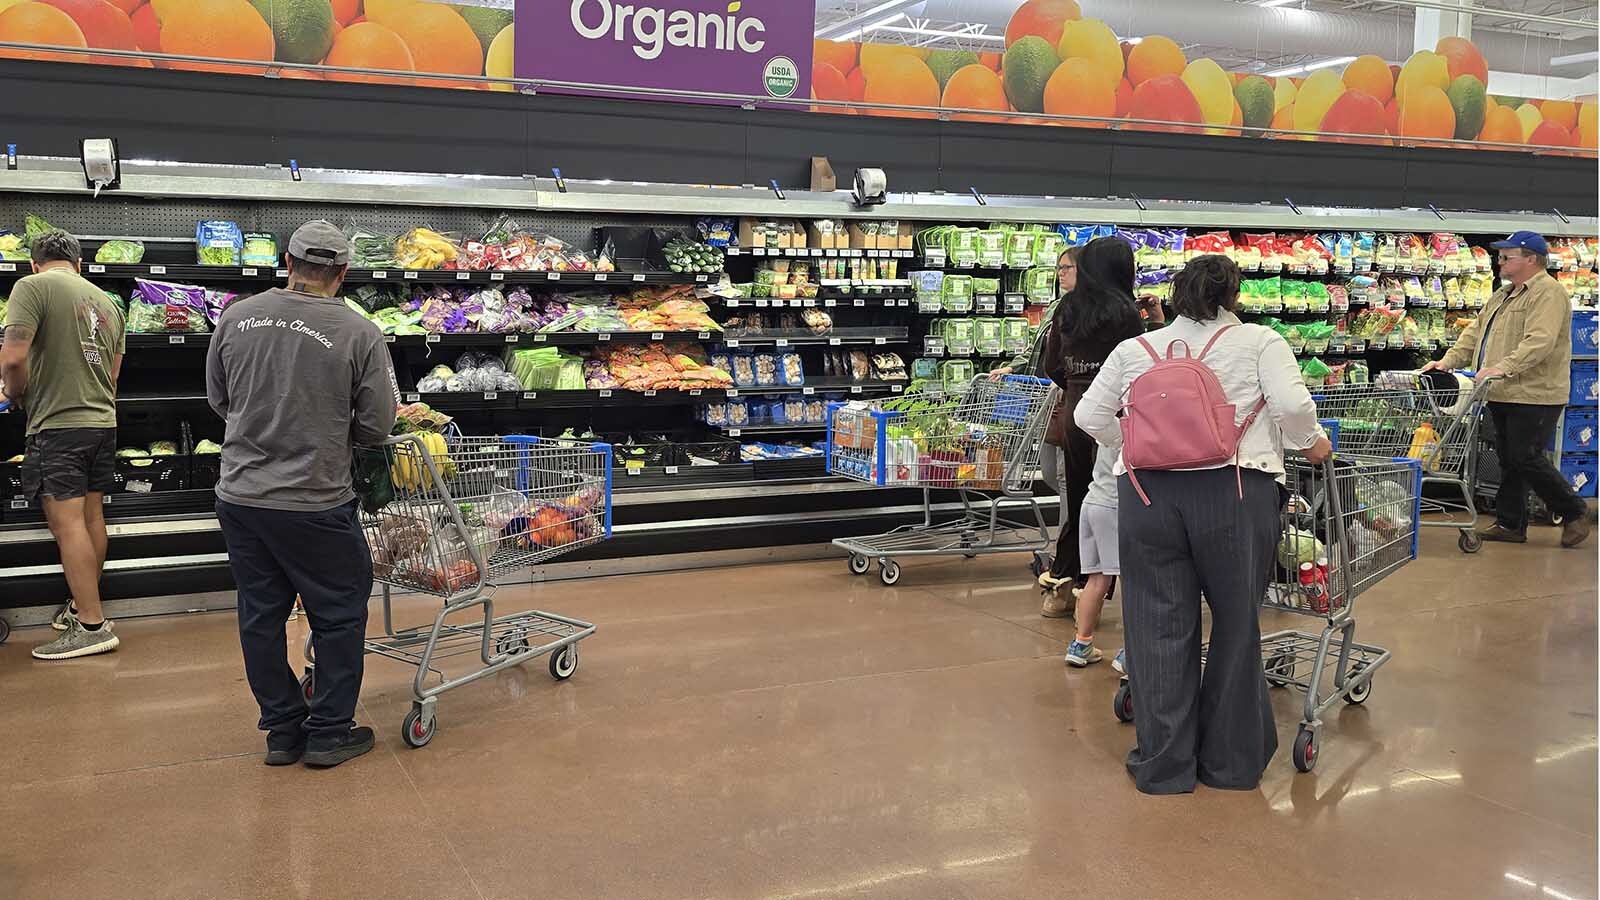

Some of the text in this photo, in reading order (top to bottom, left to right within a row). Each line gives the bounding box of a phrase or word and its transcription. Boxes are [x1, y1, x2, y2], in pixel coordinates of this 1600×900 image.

[570, 0, 766, 60] Organic
[771, 66, 791, 76] USDA
[768, 78, 793, 87] ORGANIC
[237, 316, 333, 349] Made in America
